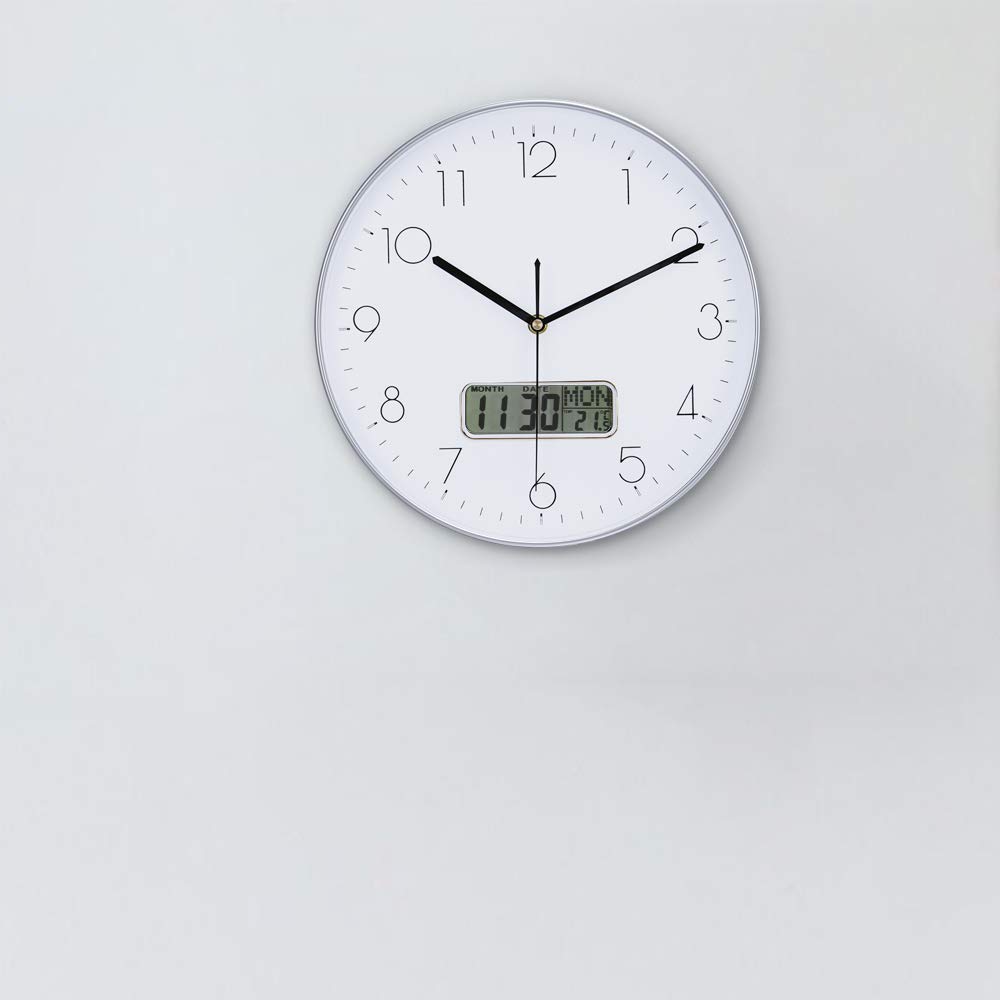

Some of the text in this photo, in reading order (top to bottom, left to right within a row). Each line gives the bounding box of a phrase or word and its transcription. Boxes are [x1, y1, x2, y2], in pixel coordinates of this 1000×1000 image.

[517, 141, 557, 178] 12
[437, 170, 465, 206] 11
[621, 168, 630, 205] 1
[382, 226, 432, 264] 10
[671, 226, 700, 264] 2
[353, 305, 381, 342] 9
[697, 303, 723, 340] 3
[380, 385, 405, 423] 8
[478, 394, 559, 431] 11 30
[564, 386, 612, 406] MON
[676, 384, 699, 420] 4
[439, 447, 463, 484] 7
[618, 446, 646, 484] 5
[529, 471, 557, 509] 6
